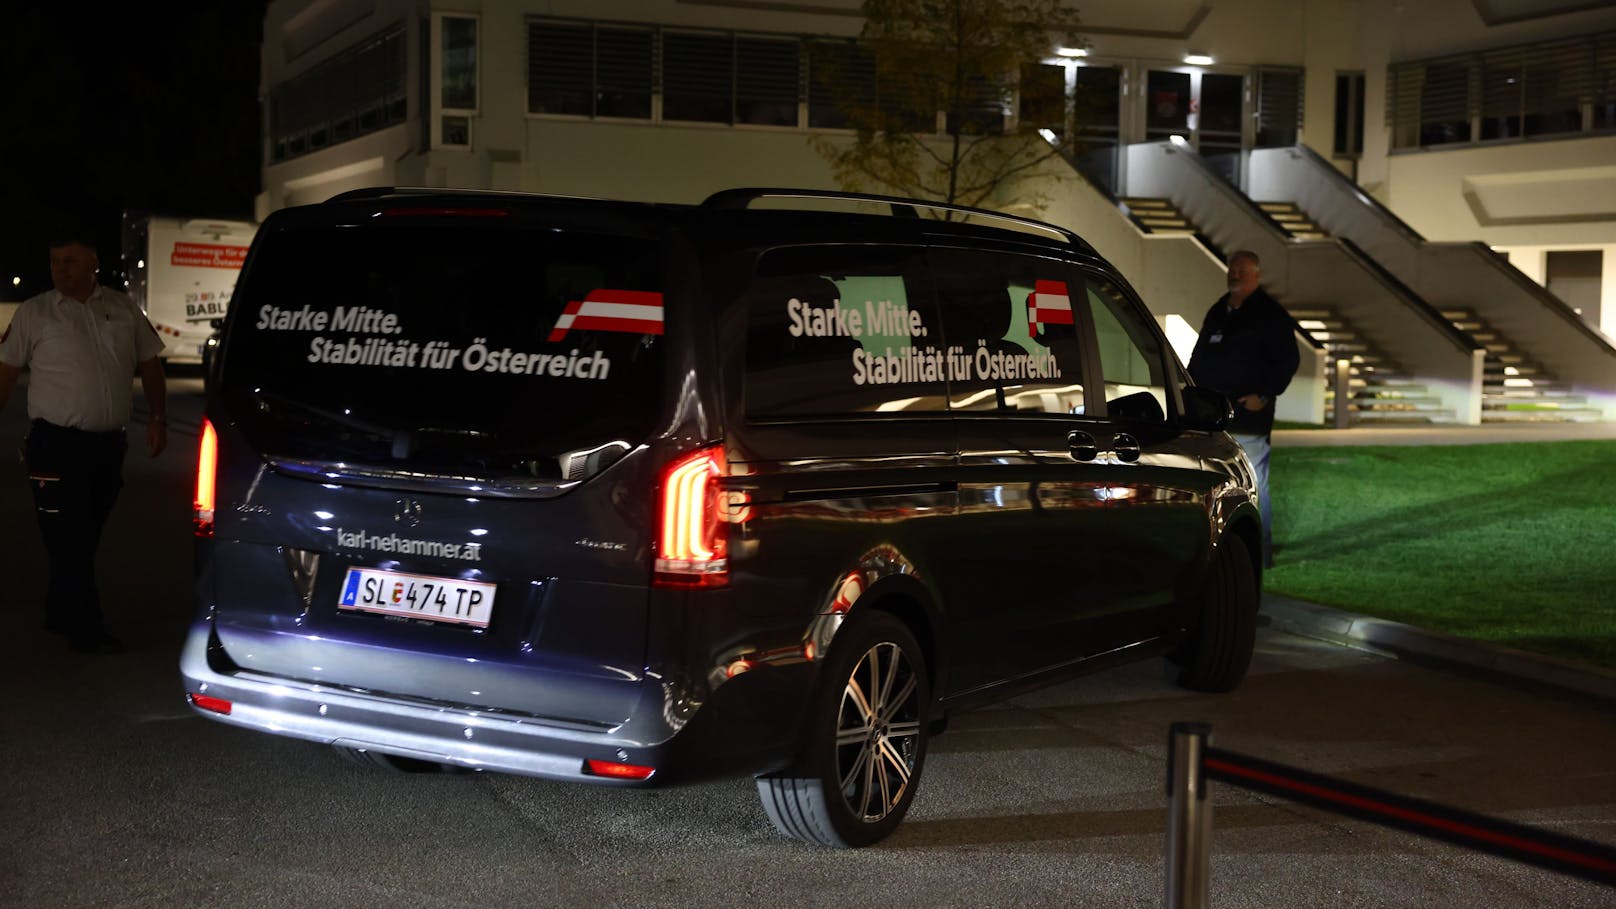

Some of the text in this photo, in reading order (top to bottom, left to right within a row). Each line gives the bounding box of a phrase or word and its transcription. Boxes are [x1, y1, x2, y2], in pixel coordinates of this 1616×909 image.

[225, 247, 237, 257] für
[186, 302, 230, 316] BABL
[256, 304, 402, 334] Starke Mitte.
[787, 298, 928, 337] Starke Mitte.
[307, 337, 611, 380] Stabilität für Österreich
[852, 338, 1062, 385] Stabilität für Österreich.
[337, 528, 482, 562] karl-nehammer.at
[346, 577, 484, 616] A SL 474 TP
